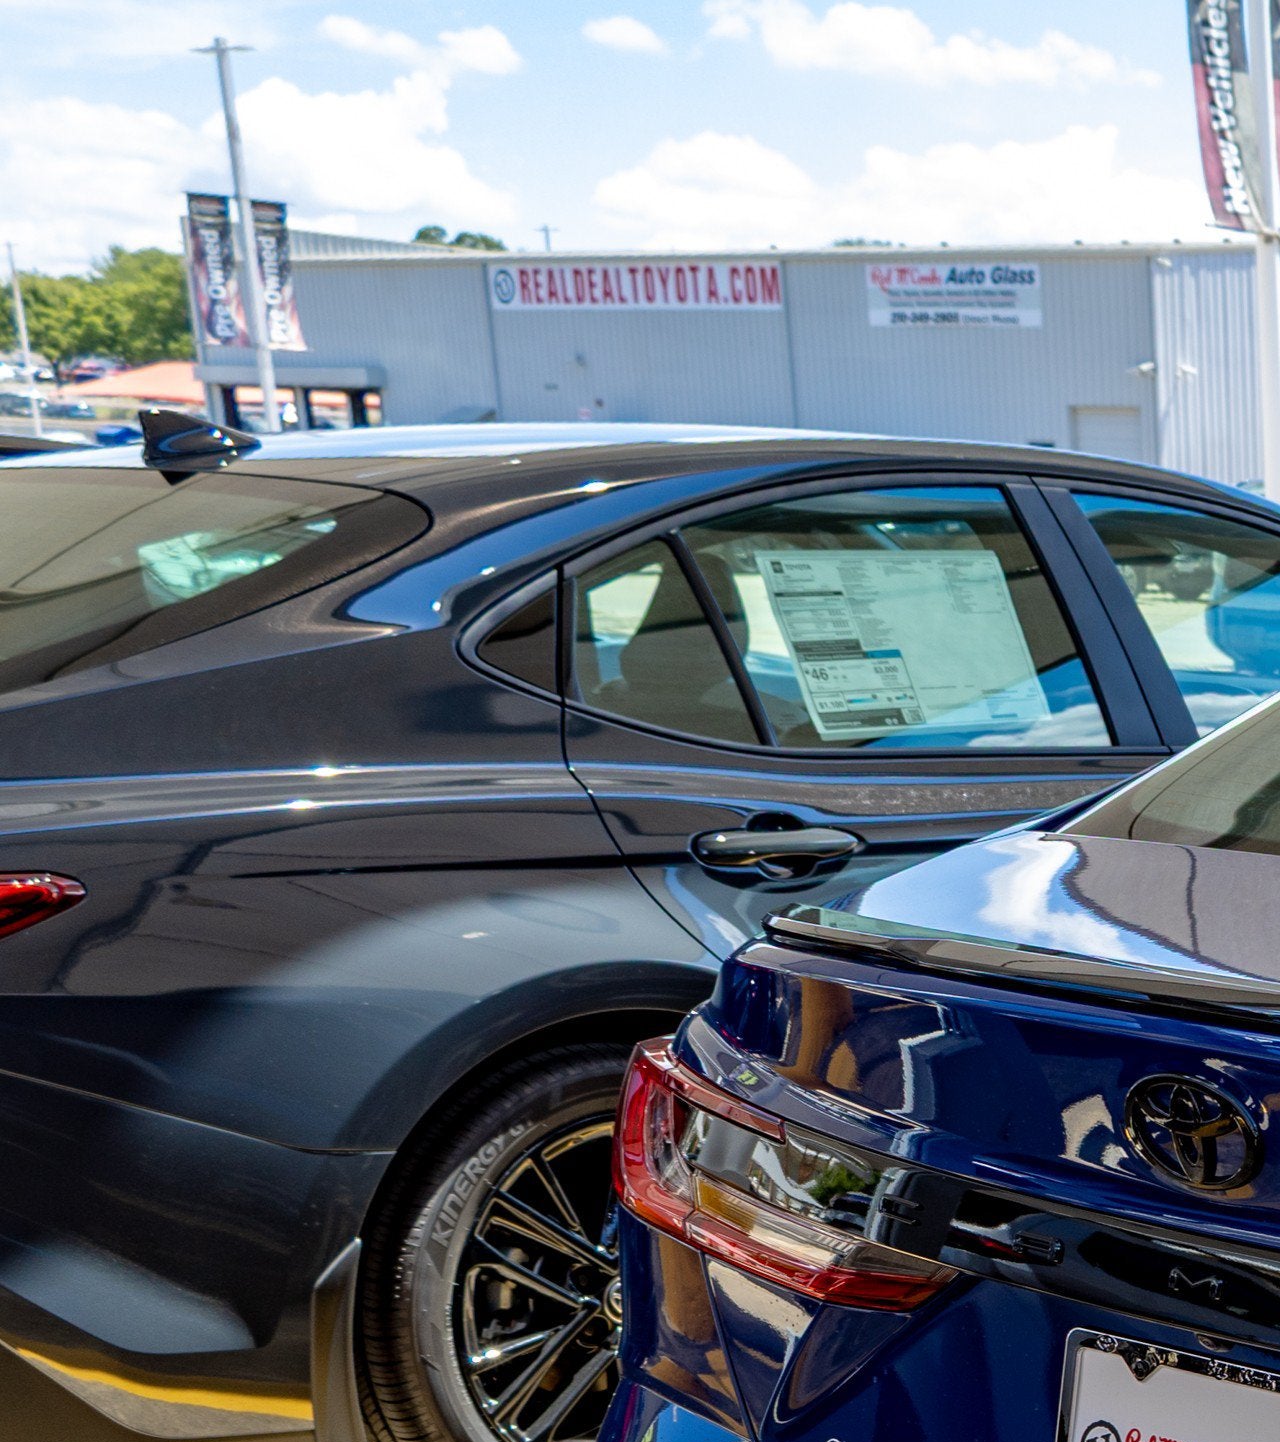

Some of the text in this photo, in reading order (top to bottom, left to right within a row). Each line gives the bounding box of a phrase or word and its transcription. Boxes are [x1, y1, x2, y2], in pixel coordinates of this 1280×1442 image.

[200, 229, 227, 299] Owned
[258, 236, 282, 304] Owned
[518, 265, 782, 305] REALDEALTOYOTA.COM
[946, 267, 986, 284] Auto
[991, 266, 1036, 285] Glass
[811, 667, 829, 681] 46
[431, 1134, 505, 1248] KINERGY
